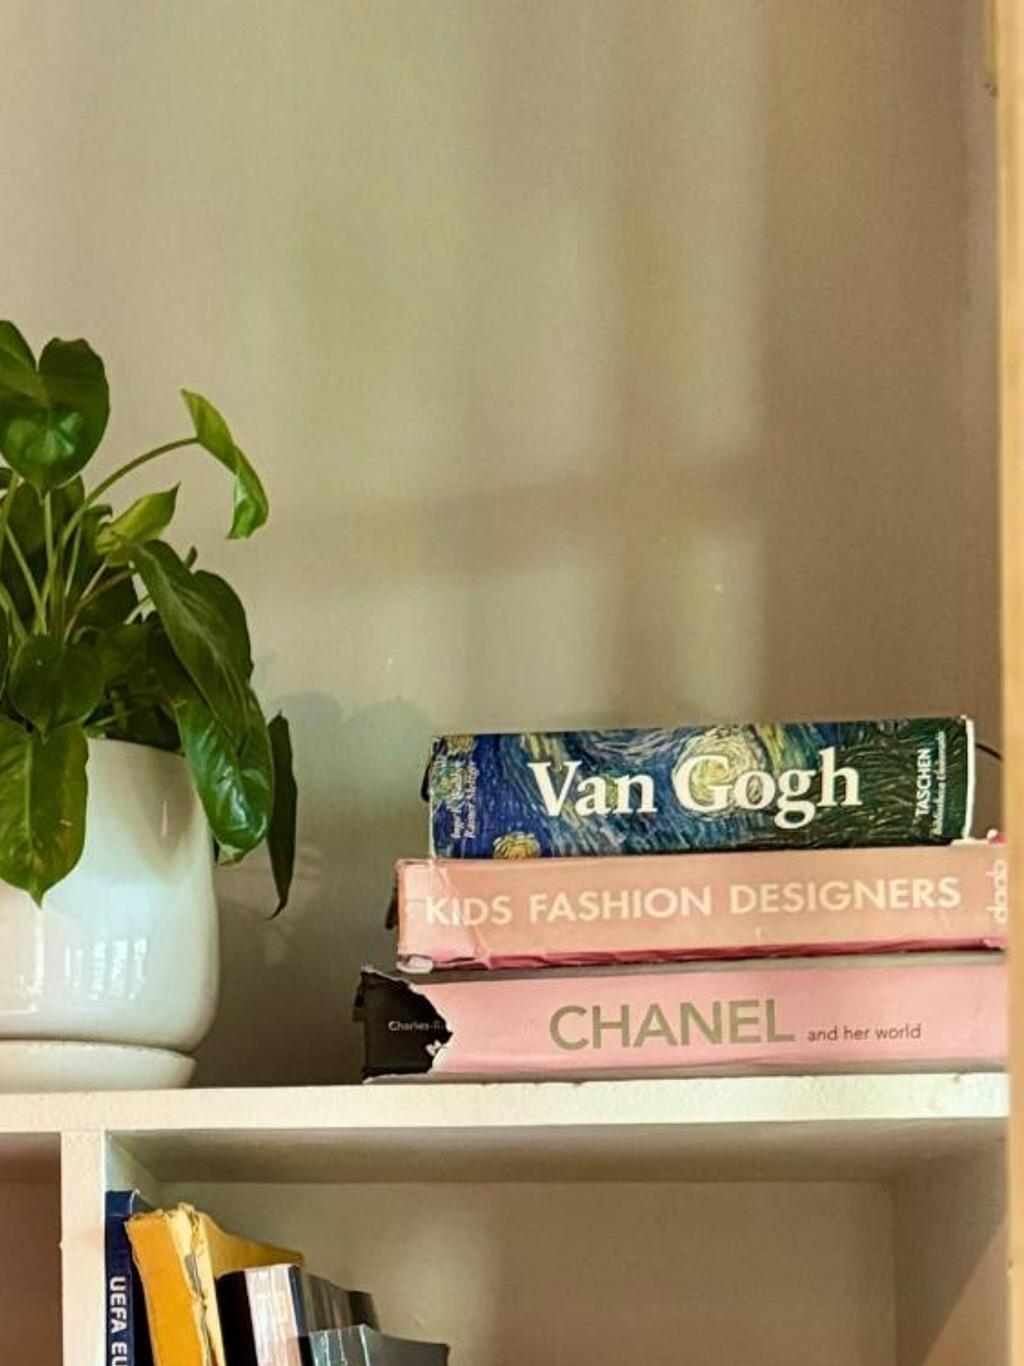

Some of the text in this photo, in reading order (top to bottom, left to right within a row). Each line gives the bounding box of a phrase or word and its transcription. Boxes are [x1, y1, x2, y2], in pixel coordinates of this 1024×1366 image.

[528, 759, 659, 818] Van
[672, 746, 864, 830] Gogh
[914, 747, 932, 818] TASCHEN
[528, 876, 963, 924] FASHION DESIGNERS
[548, 998, 923, 1052] CHANEL and her world
[109, 1276, 127, 1334] UEFA
